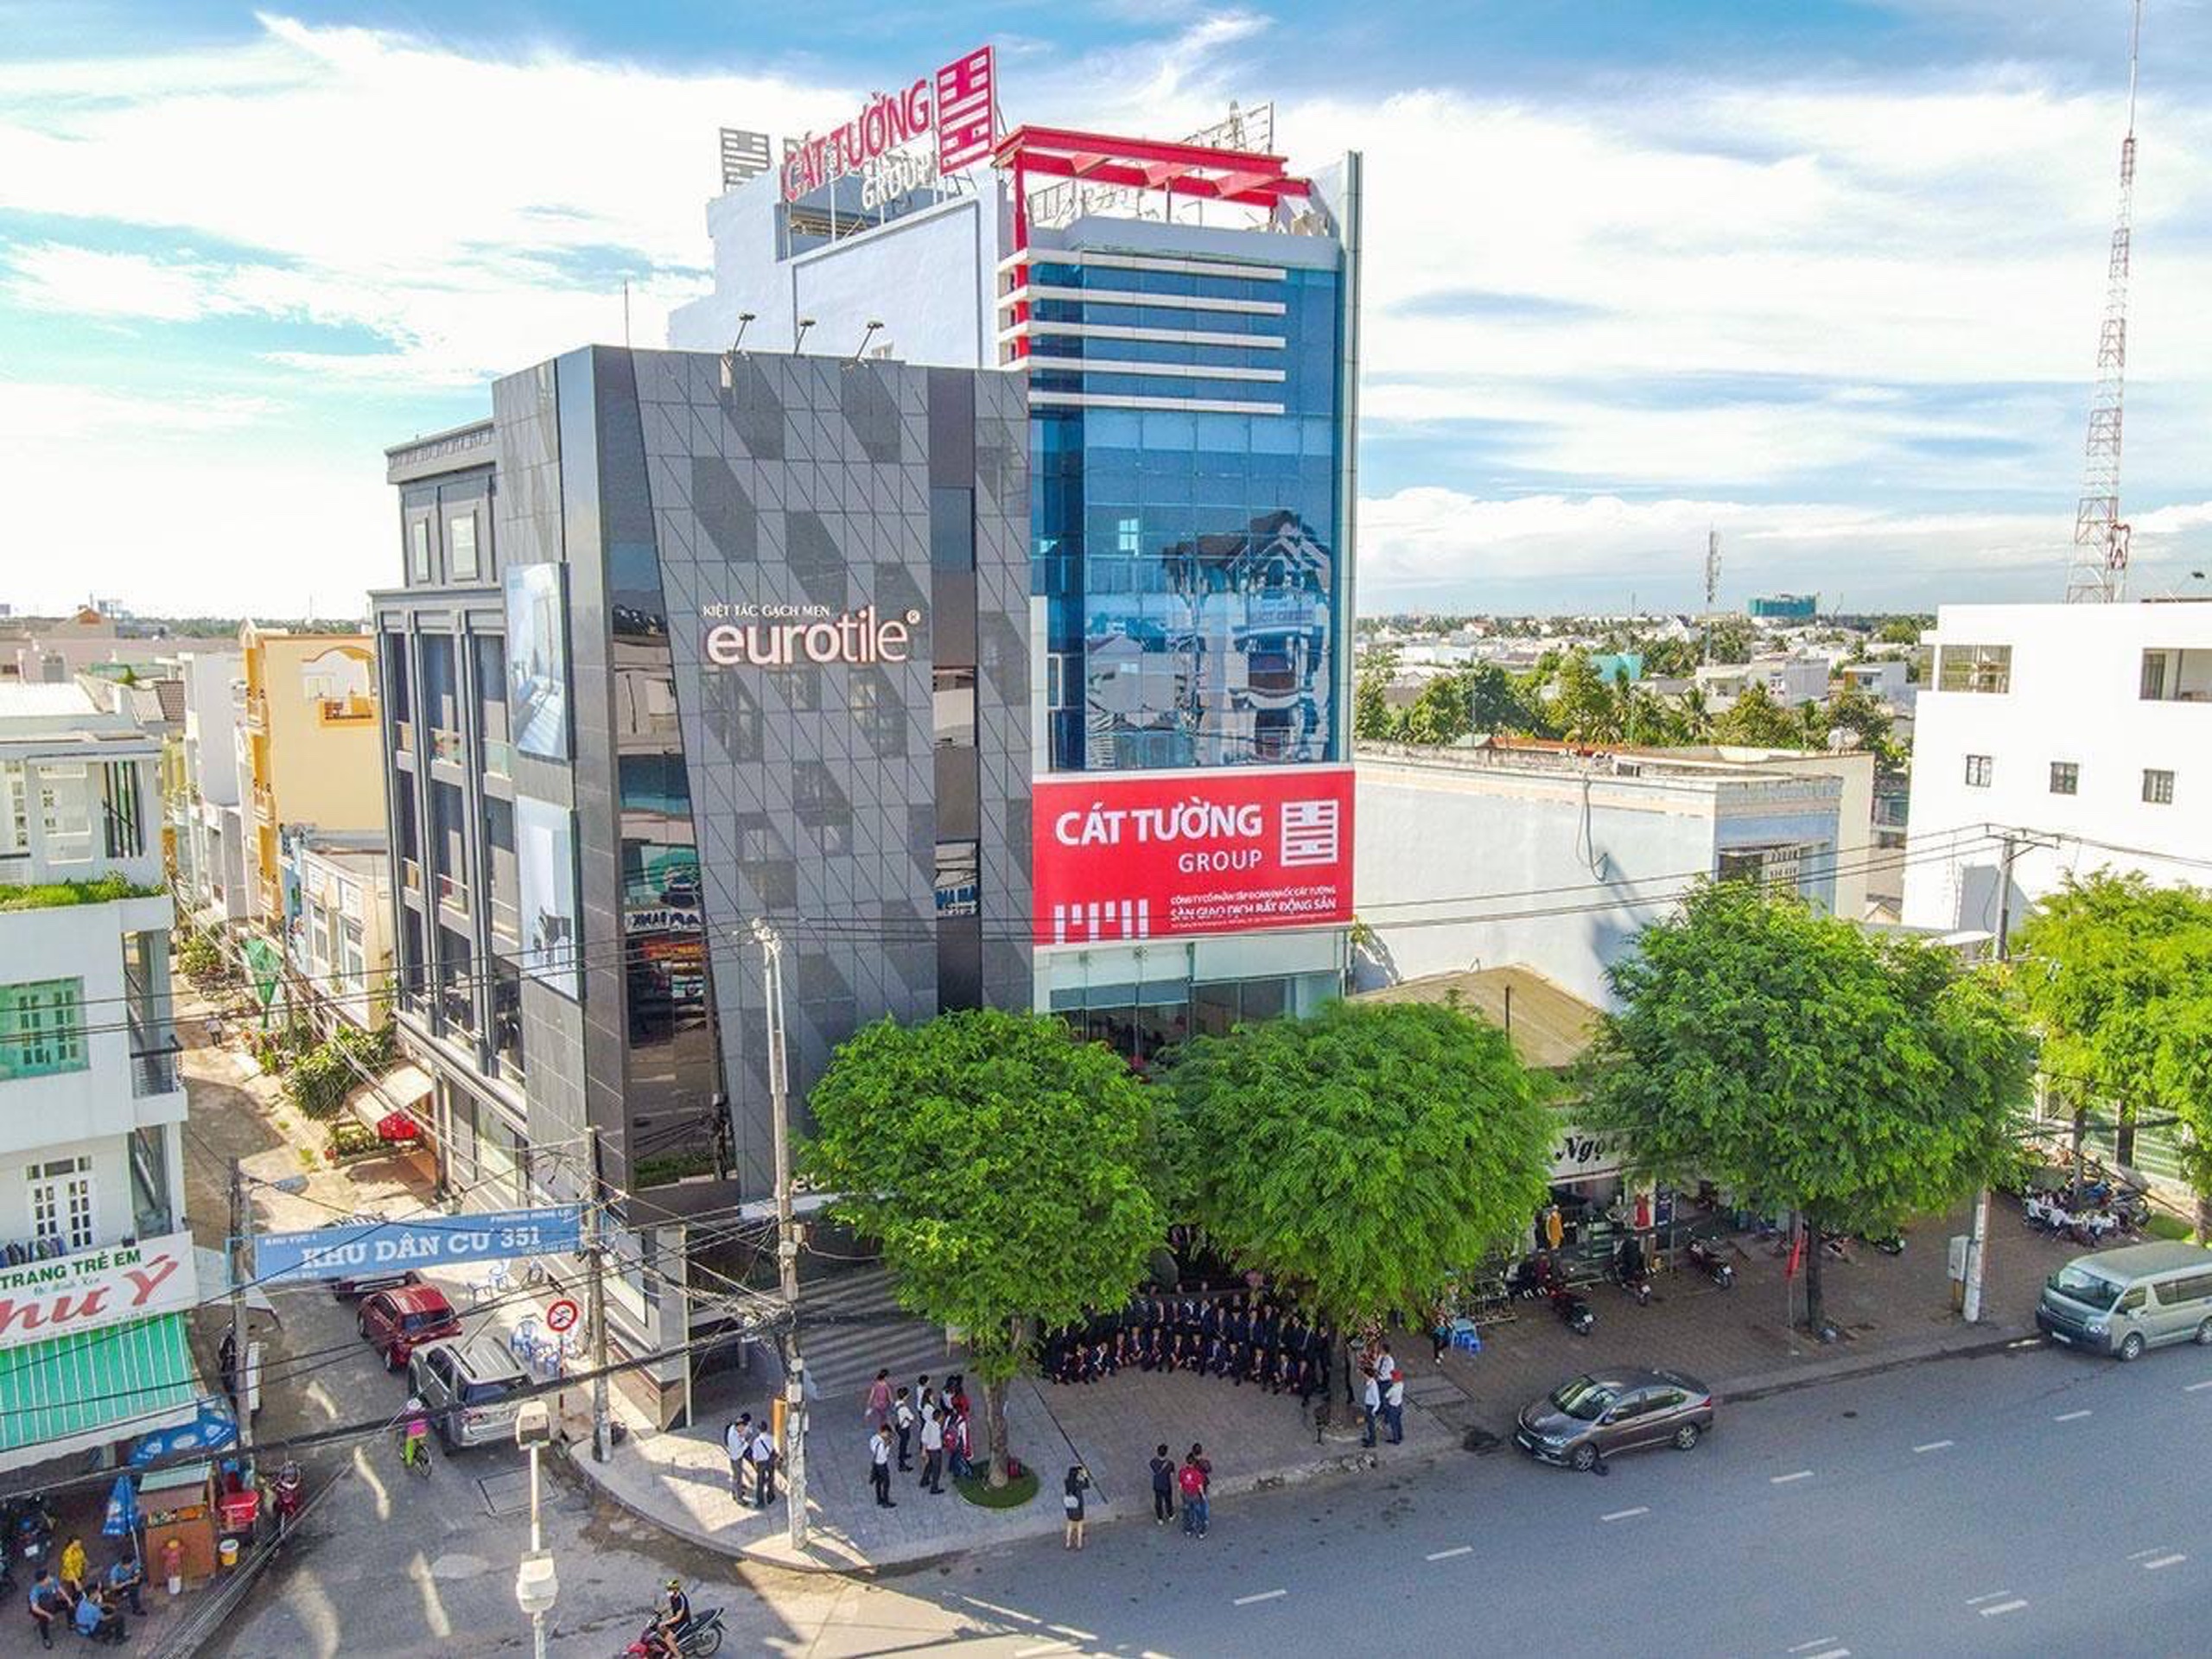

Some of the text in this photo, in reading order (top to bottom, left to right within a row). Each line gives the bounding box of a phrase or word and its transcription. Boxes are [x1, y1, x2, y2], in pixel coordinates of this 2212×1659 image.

[830, 79, 930, 178] TƯỜNG
[734, 603, 759, 616] TÁC
[762, 604, 799, 618] GẠCH
[1055, 796, 1262, 845] CÁT TƯỜNG
[1179, 849, 1262, 872] GROUP
[0, 1265, 67, 1289] TRANG
[72, 1251, 109, 1275] TRẺ
[114, 1249, 142, 1268] EM
[301, 1243, 367, 1269] KHU
[375, 1232, 440, 1262] DÂN
[500, 1225, 541, 1249] 351
[121, 1254, 179, 1306] Ý
